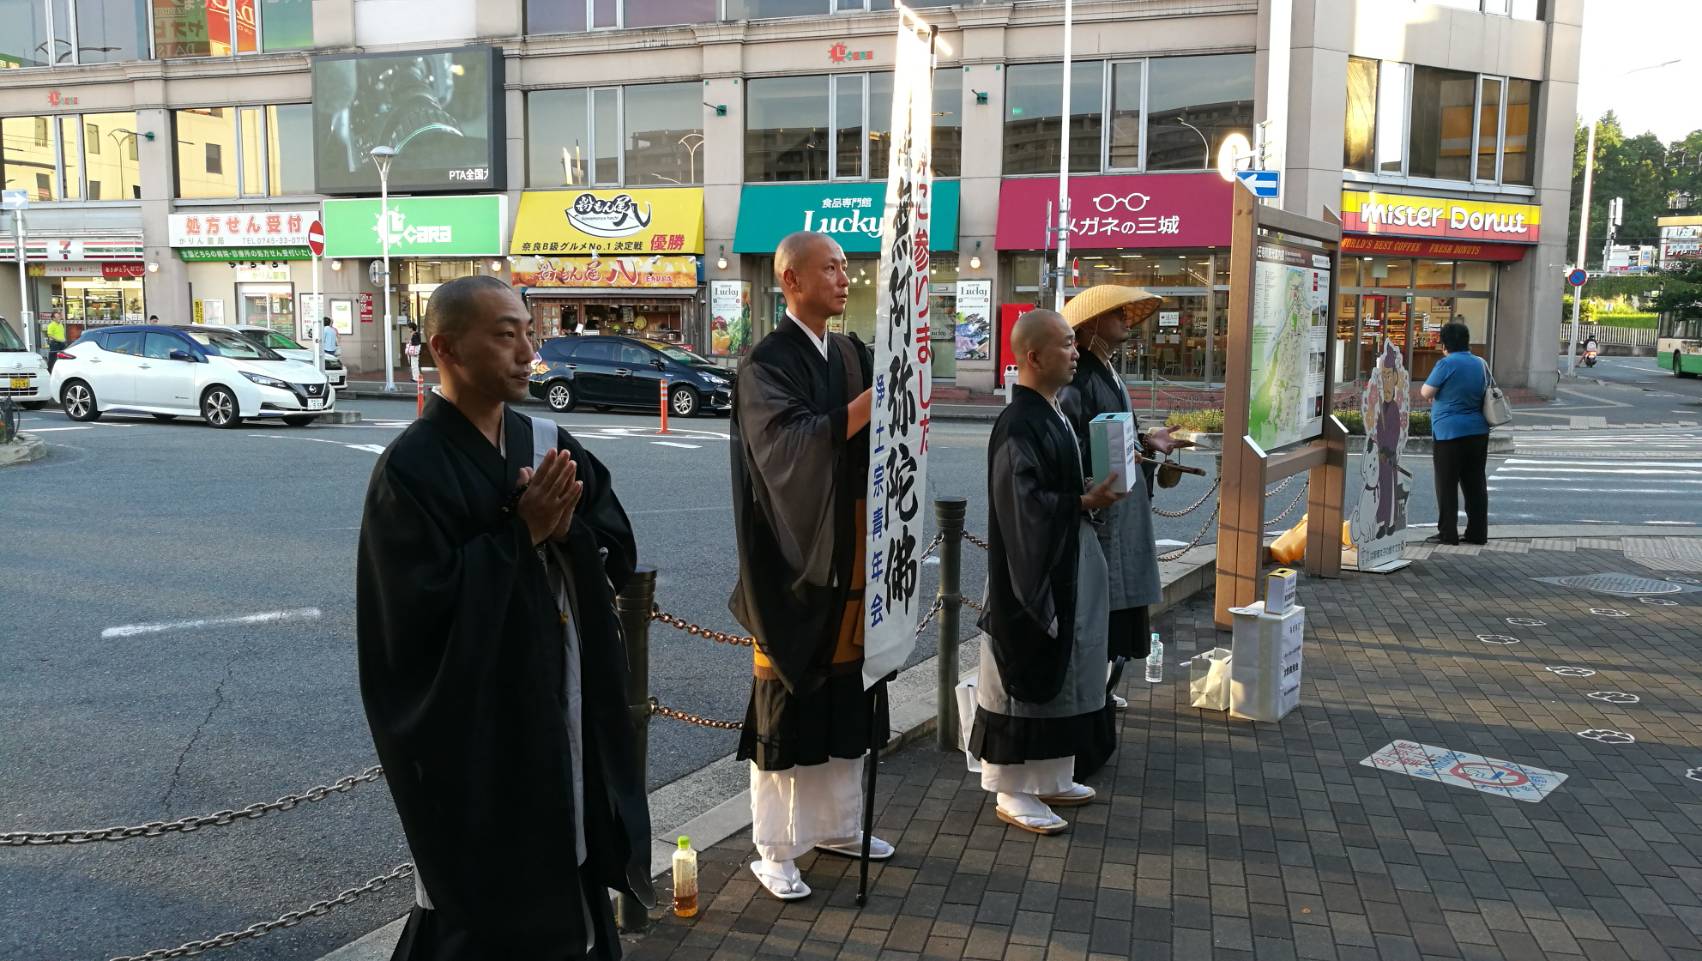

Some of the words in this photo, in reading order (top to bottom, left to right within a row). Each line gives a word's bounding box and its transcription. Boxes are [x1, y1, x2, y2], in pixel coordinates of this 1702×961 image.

[822, 197, 873, 208] 食品専門館
[186, 214, 303, 235] 処方せん受付
[803, 209, 884, 238] Lucky
[1067, 216, 1180, 235] メガネの三城
[1361, 203, 1444, 228] Mister
[1450, 206, 1528, 234] Donut
[650, 234, 685, 251] 優勝
